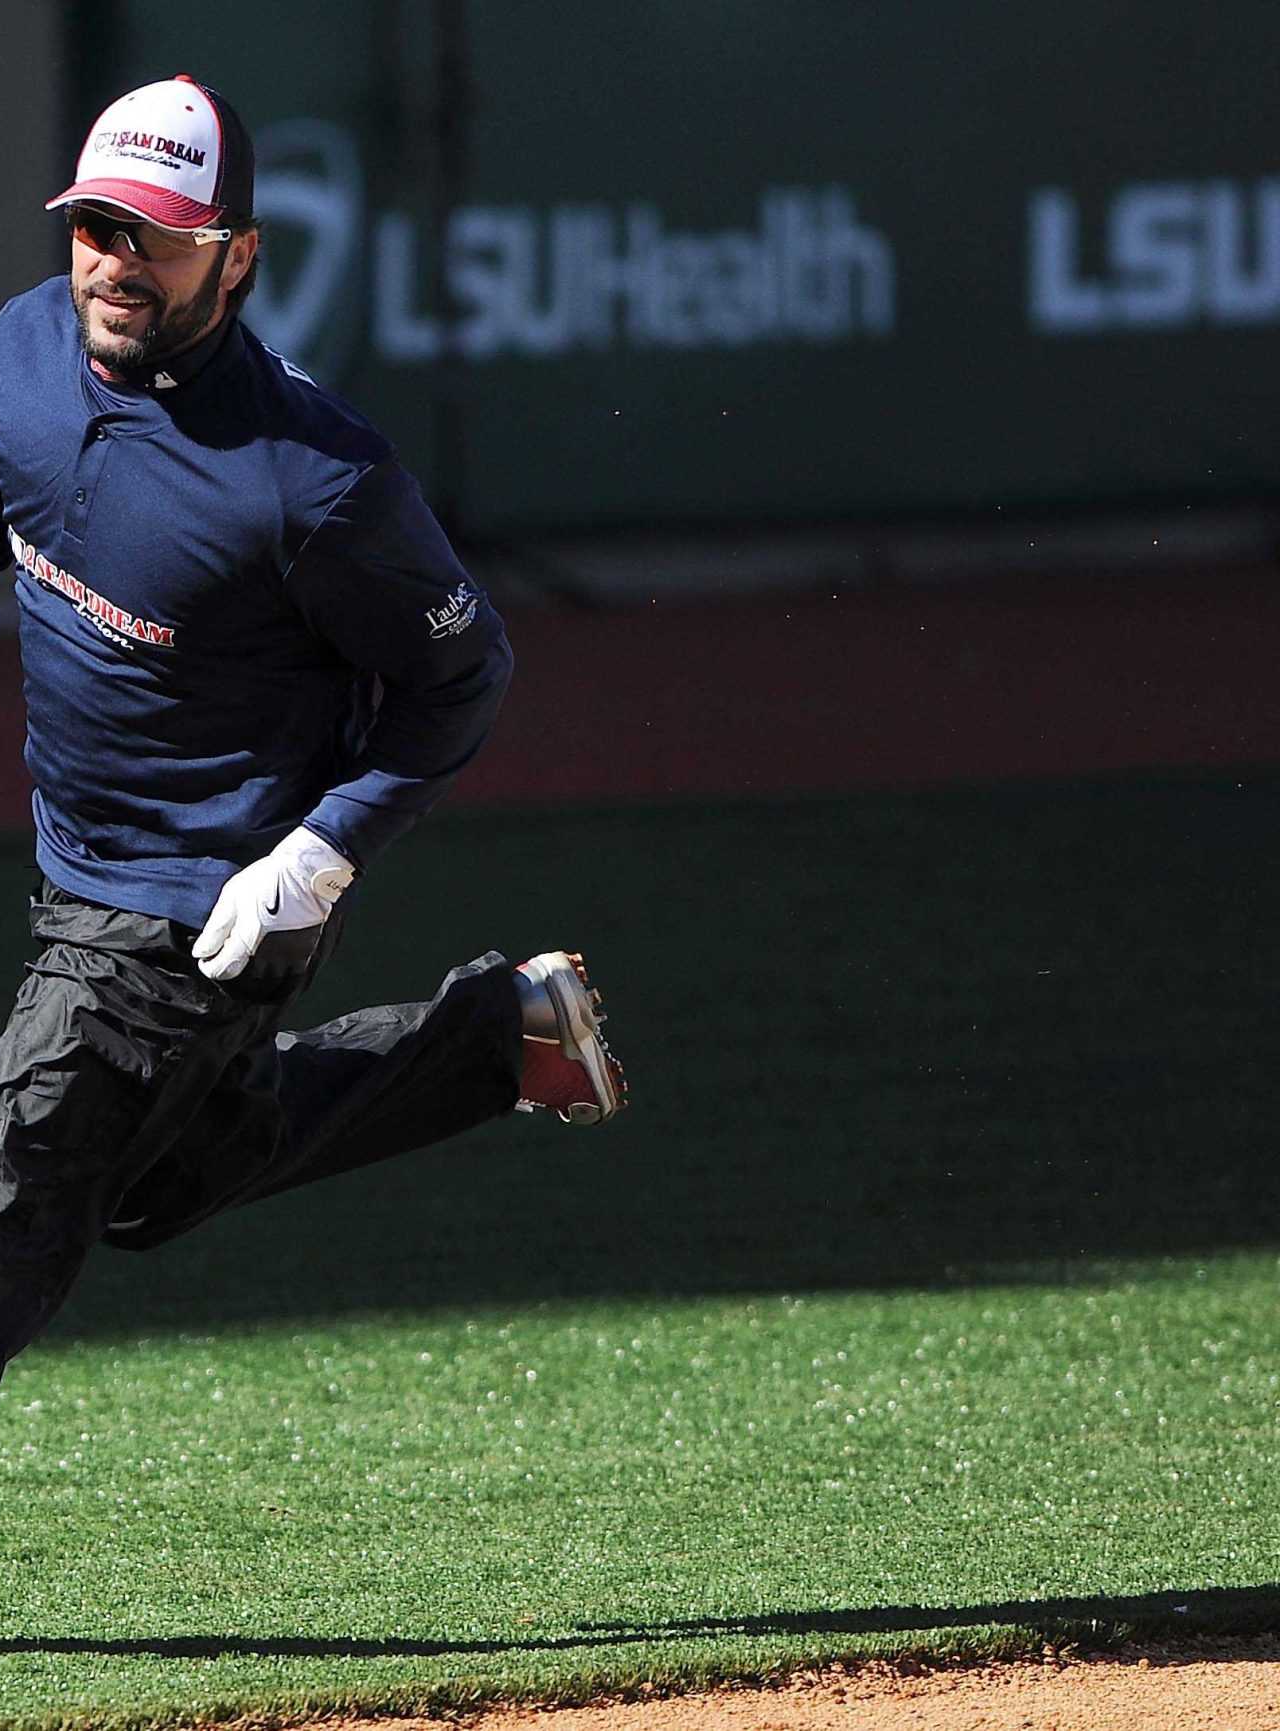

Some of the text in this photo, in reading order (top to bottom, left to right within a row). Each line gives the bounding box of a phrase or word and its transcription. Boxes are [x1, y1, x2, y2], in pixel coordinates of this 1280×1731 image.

[154, 137, 206, 168] DREAM
[1029, 181, 1280, 332] LSU
[35, 553, 86, 605] SEAM
[86, 587, 174, 647] DREAM
